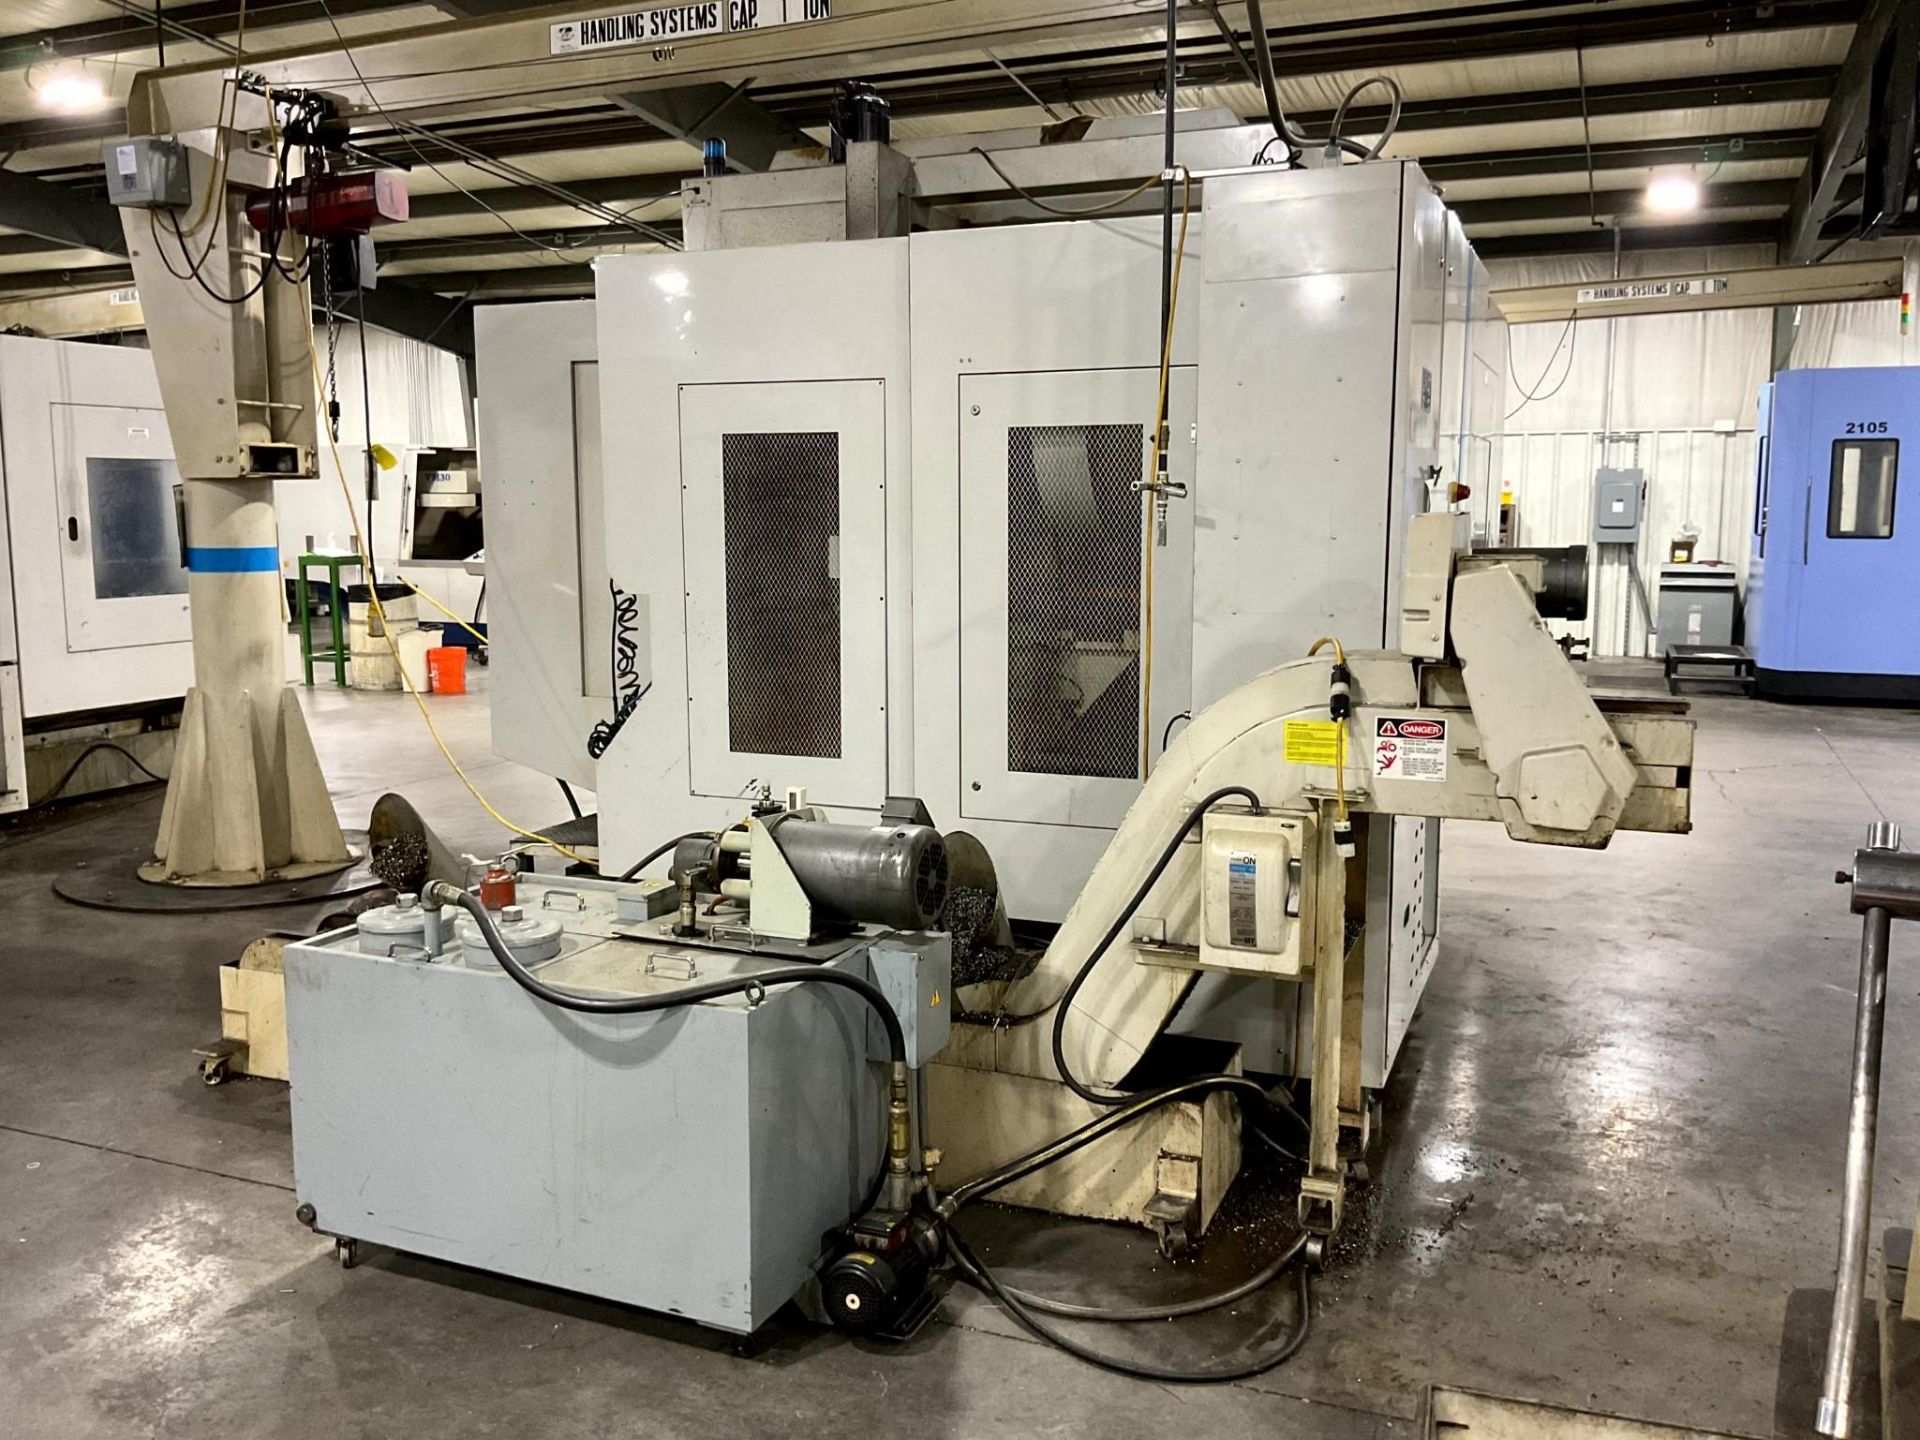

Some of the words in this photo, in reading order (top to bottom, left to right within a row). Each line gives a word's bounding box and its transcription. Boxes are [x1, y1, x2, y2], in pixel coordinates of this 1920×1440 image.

[580, 13, 645, 46] HANDLING
[650, 4, 718, 37] SYSTEMS
[729, 0, 759, 31] CAP.
[1593, 286, 1629, 300] HANDLING
[1631, 283, 1668, 298] SYSTEMS
[1845, 421, 1888, 435] 2105
[1402, 724, 1440, 735] DANGER
[1242, 856, 1257, 865] ON
